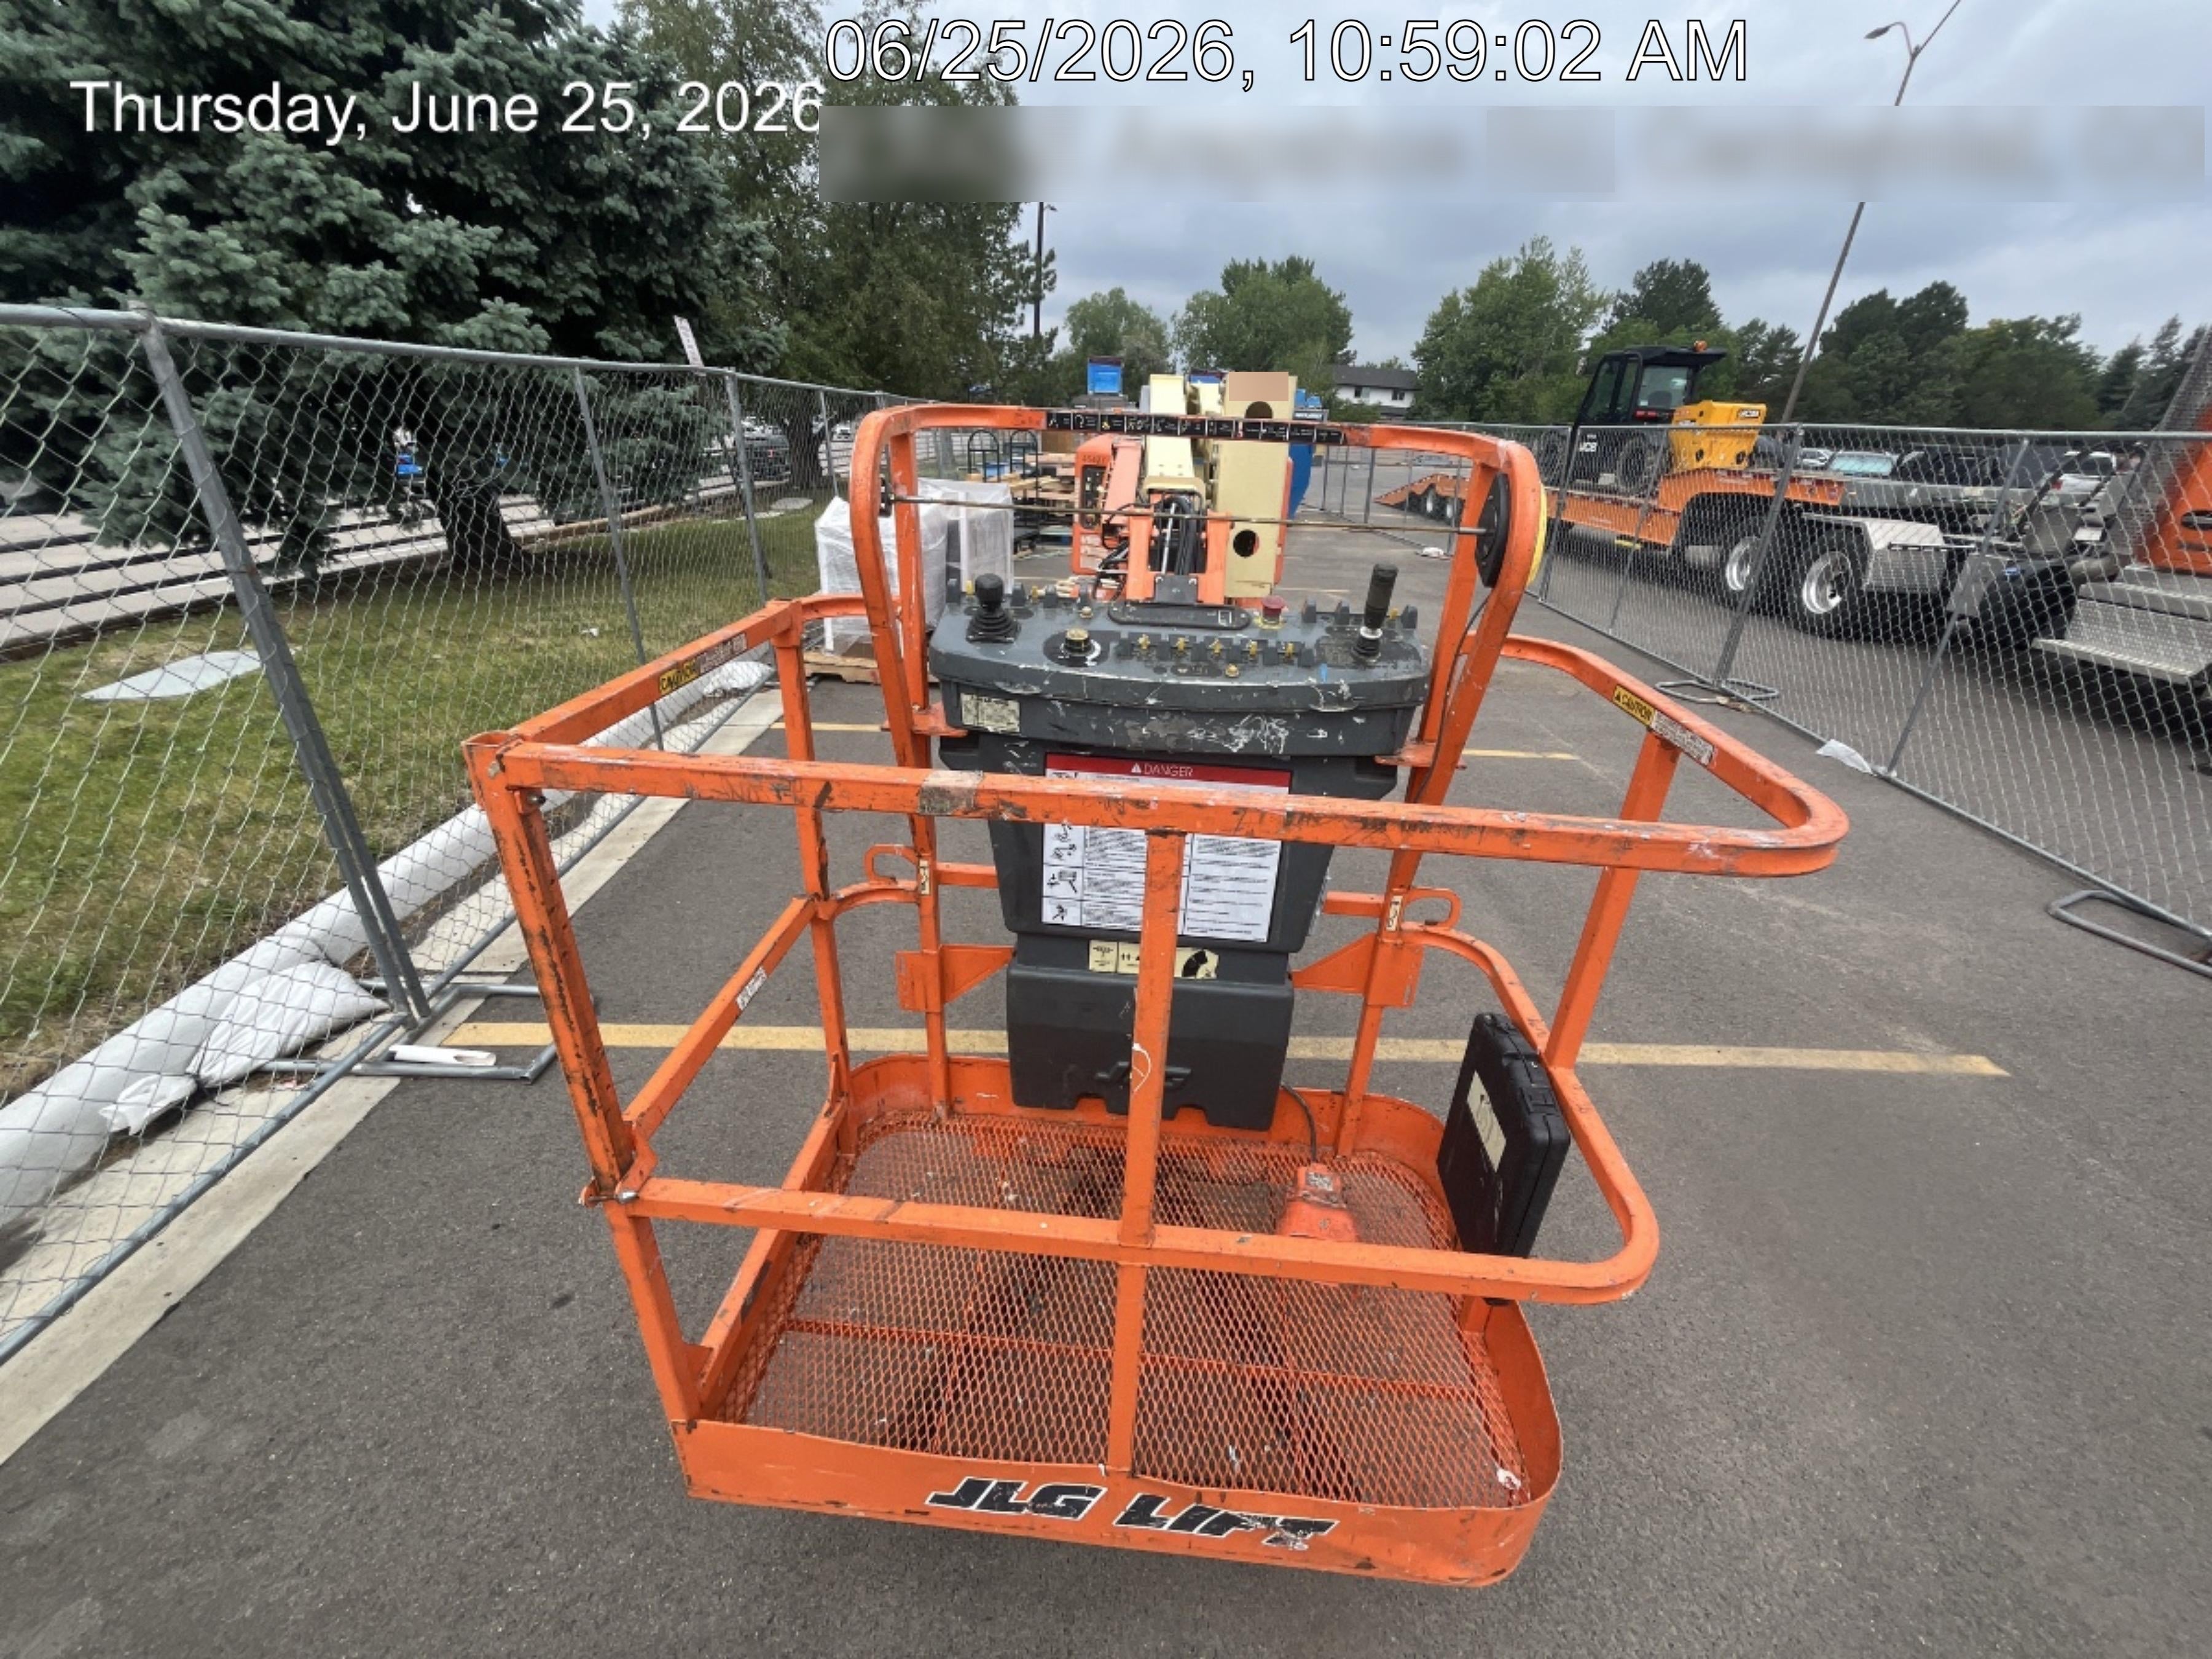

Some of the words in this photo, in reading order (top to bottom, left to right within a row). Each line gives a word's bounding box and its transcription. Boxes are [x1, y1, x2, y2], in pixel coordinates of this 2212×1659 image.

[1622, 692, 1654, 721] CAUTION
[1143, 764, 1194, 777] DANGER
[924, 1477, 1108, 1521] JLG
